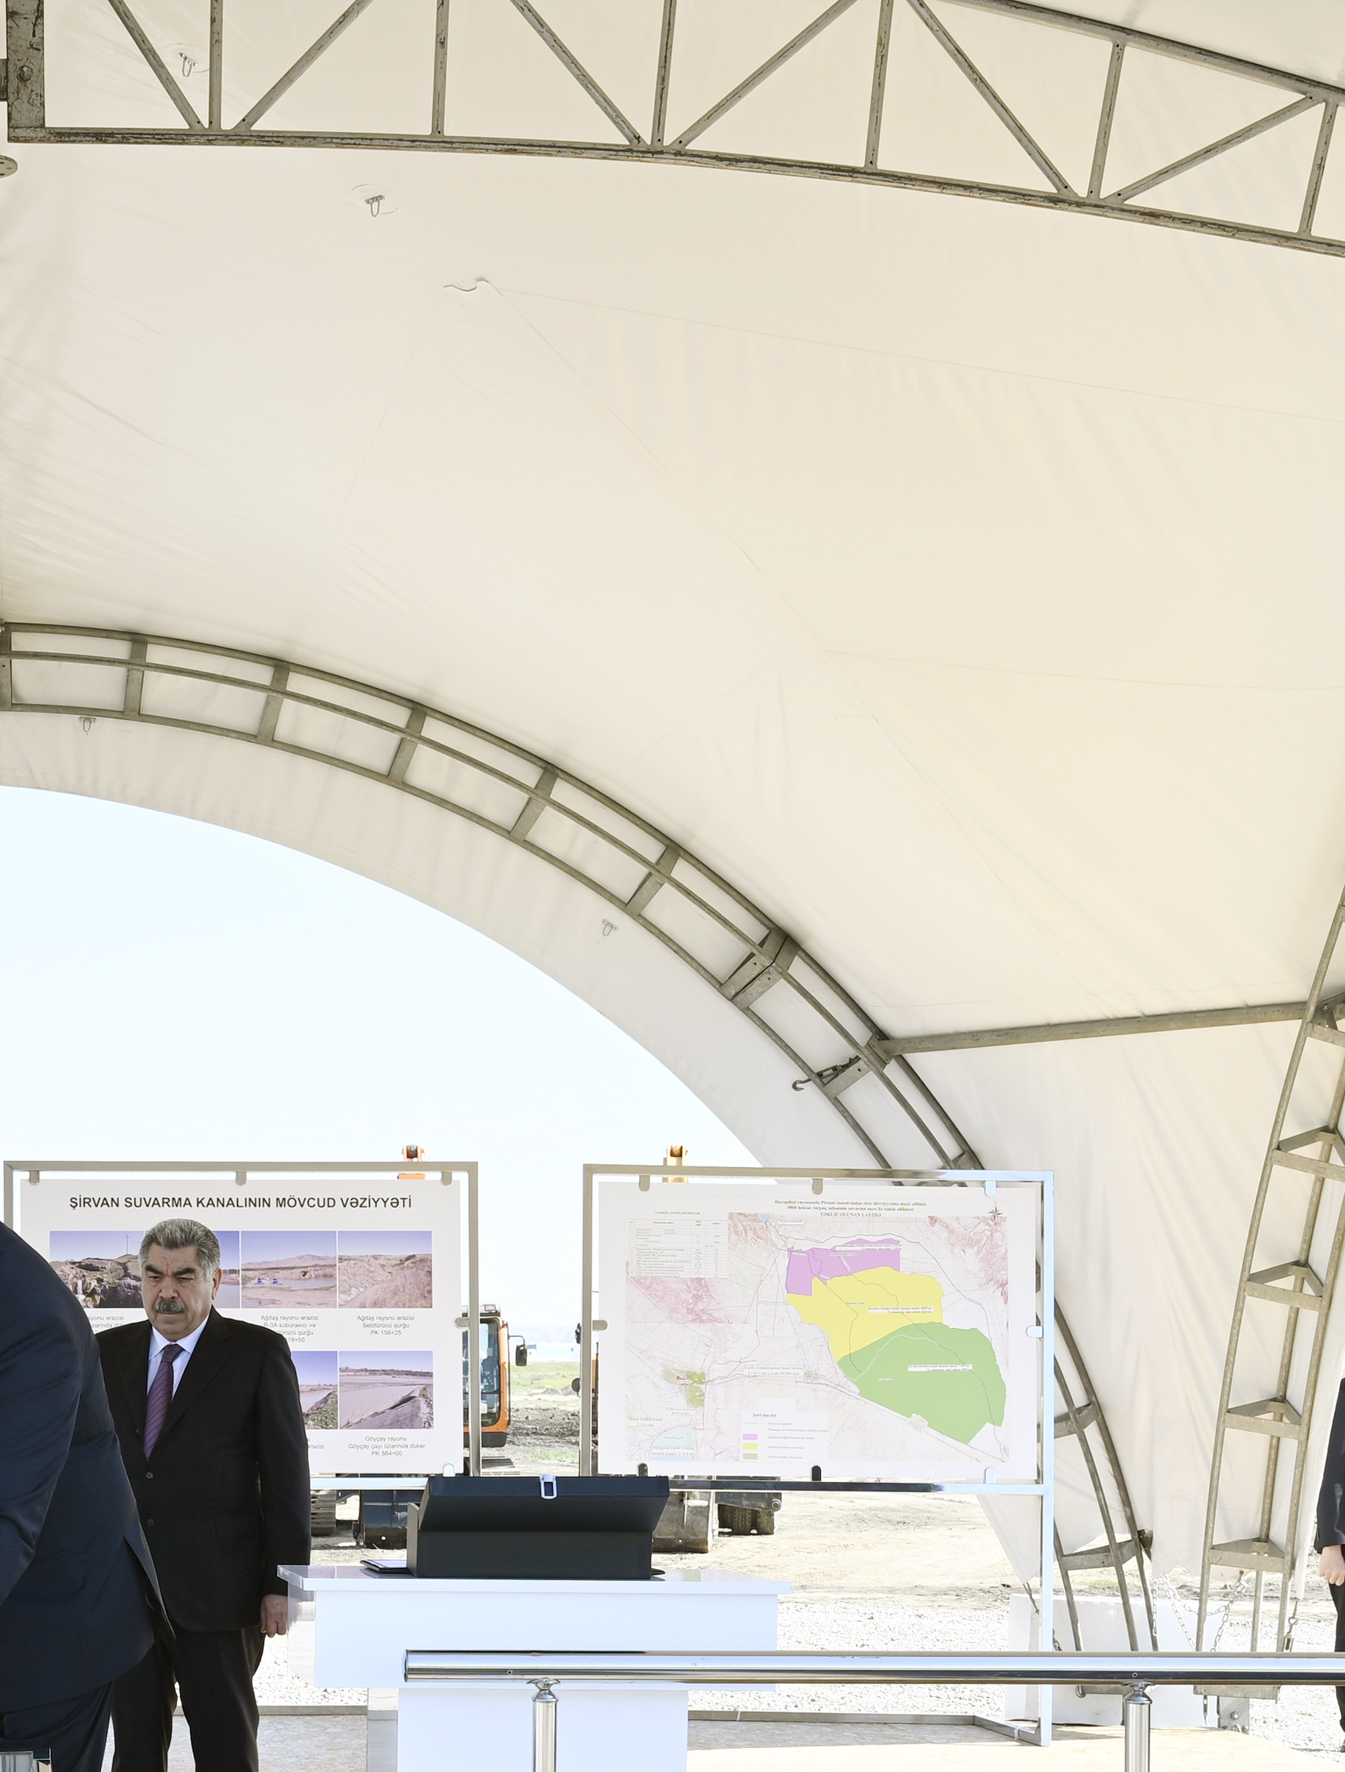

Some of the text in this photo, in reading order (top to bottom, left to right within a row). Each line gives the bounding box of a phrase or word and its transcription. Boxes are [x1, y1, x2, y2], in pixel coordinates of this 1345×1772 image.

[69, 1194, 412, 1210] ŞİRVAN SUVARMA KANALININ MÖVCUD VƏZİYYƏTİ
